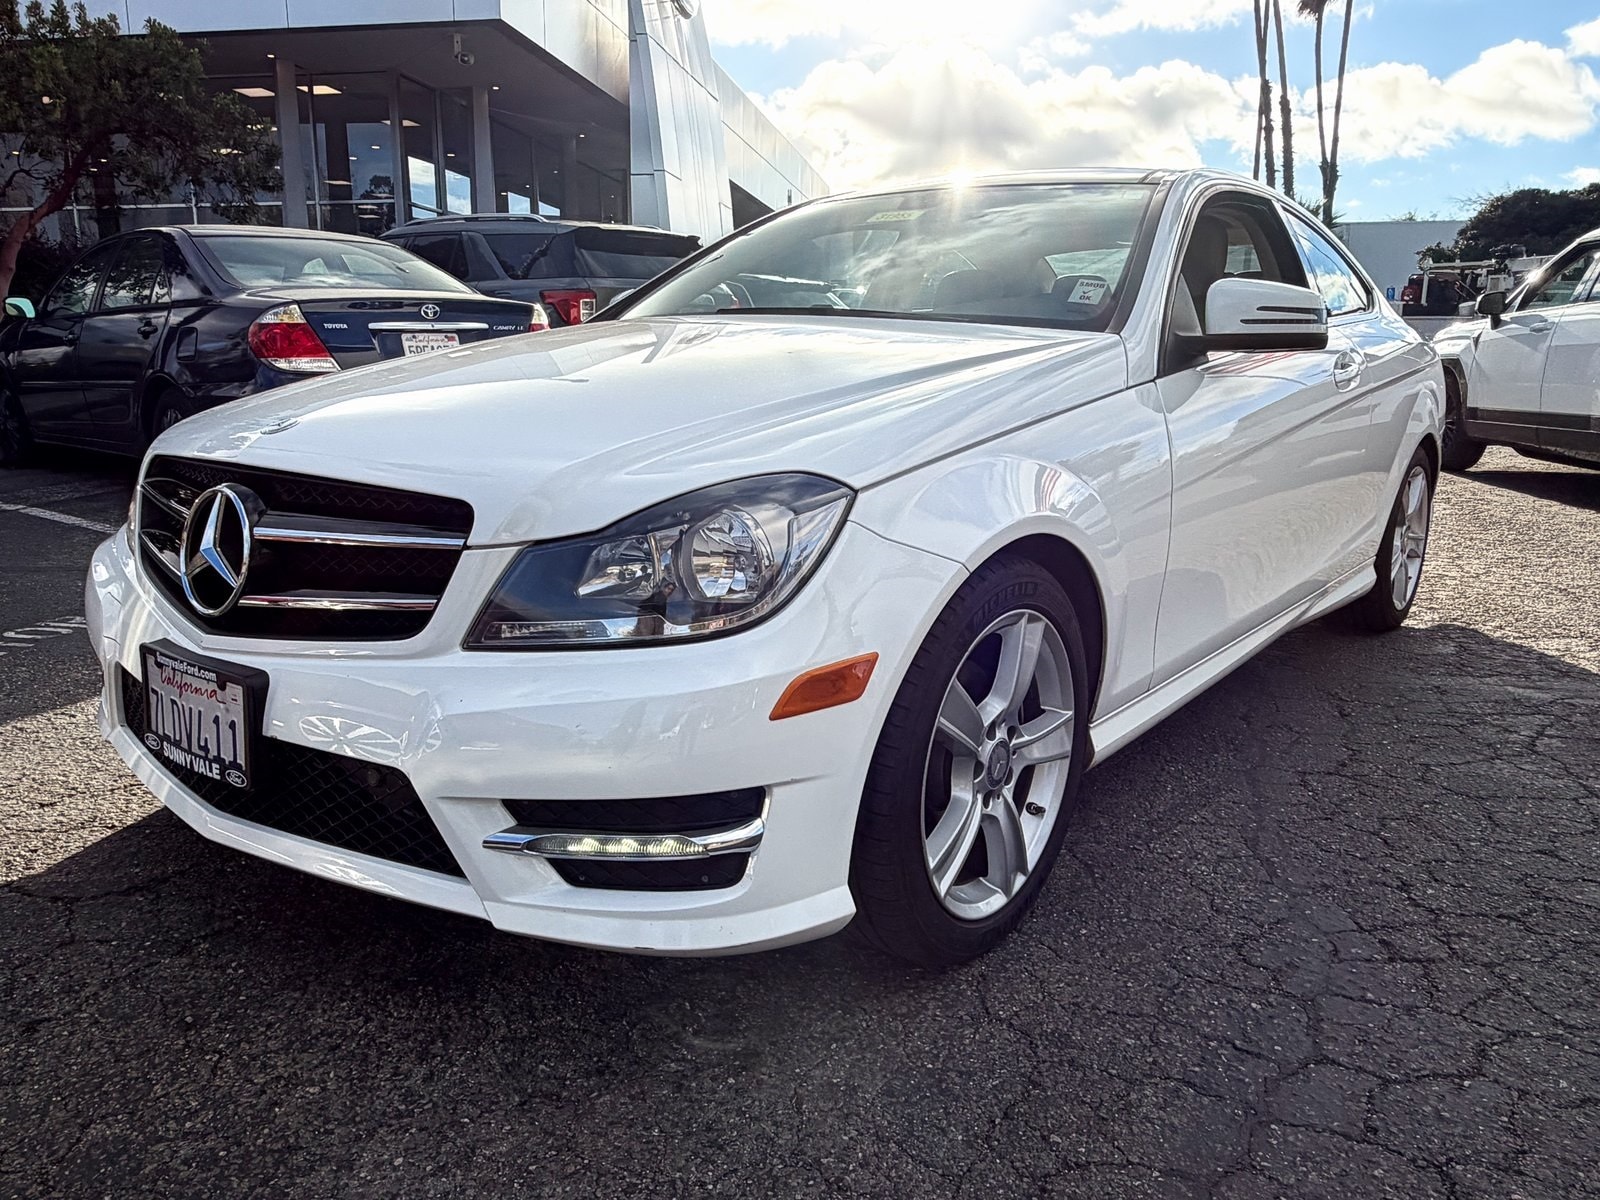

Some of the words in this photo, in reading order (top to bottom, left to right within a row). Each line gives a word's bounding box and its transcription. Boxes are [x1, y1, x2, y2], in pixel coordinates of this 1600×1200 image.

[1079, 281, 1106, 289] SMOG
[970, 581, 1040, 629] MICHELIN
[160, 666, 227, 705] California
[150, 686, 243, 770] 7LDV411
[163, 740, 221, 780] SUNNYVALE
